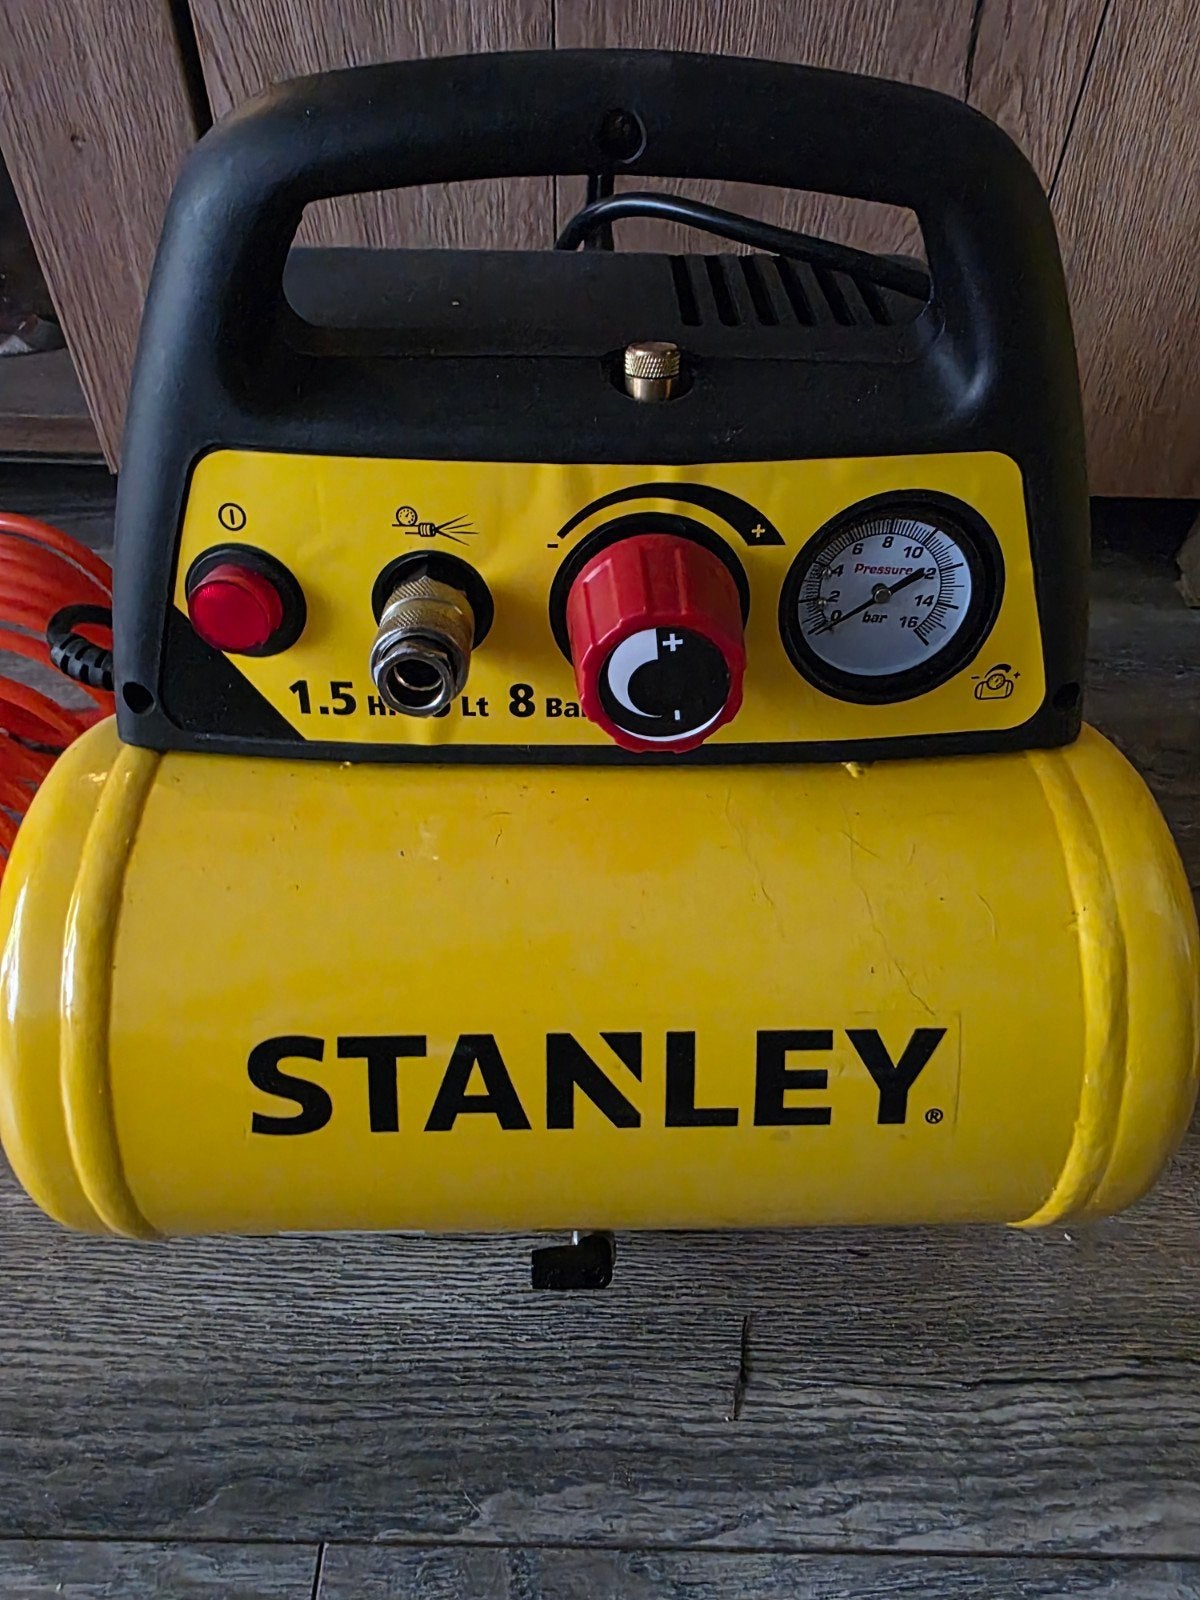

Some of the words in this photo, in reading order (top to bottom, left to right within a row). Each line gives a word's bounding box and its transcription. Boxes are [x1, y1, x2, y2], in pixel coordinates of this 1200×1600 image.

[882, 536, 894, 548] 8
[852, 543, 864, 555] 6
[903, 546, 924, 558] 10
[831, 564, 844, 577] 4
[854, 563, 914, 575] Pressure
[828, 590, 841, 603] 2
[914, 594, 935, 607] 14
[862, 611, 888, 624] bar
[899, 616, 919, 629] 16
[289, 680, 357, 715] 1.5
[367, 695, 396, 716] H
[461, 696, 489, 717] Lt
[509, 683, 536, 717] 8
